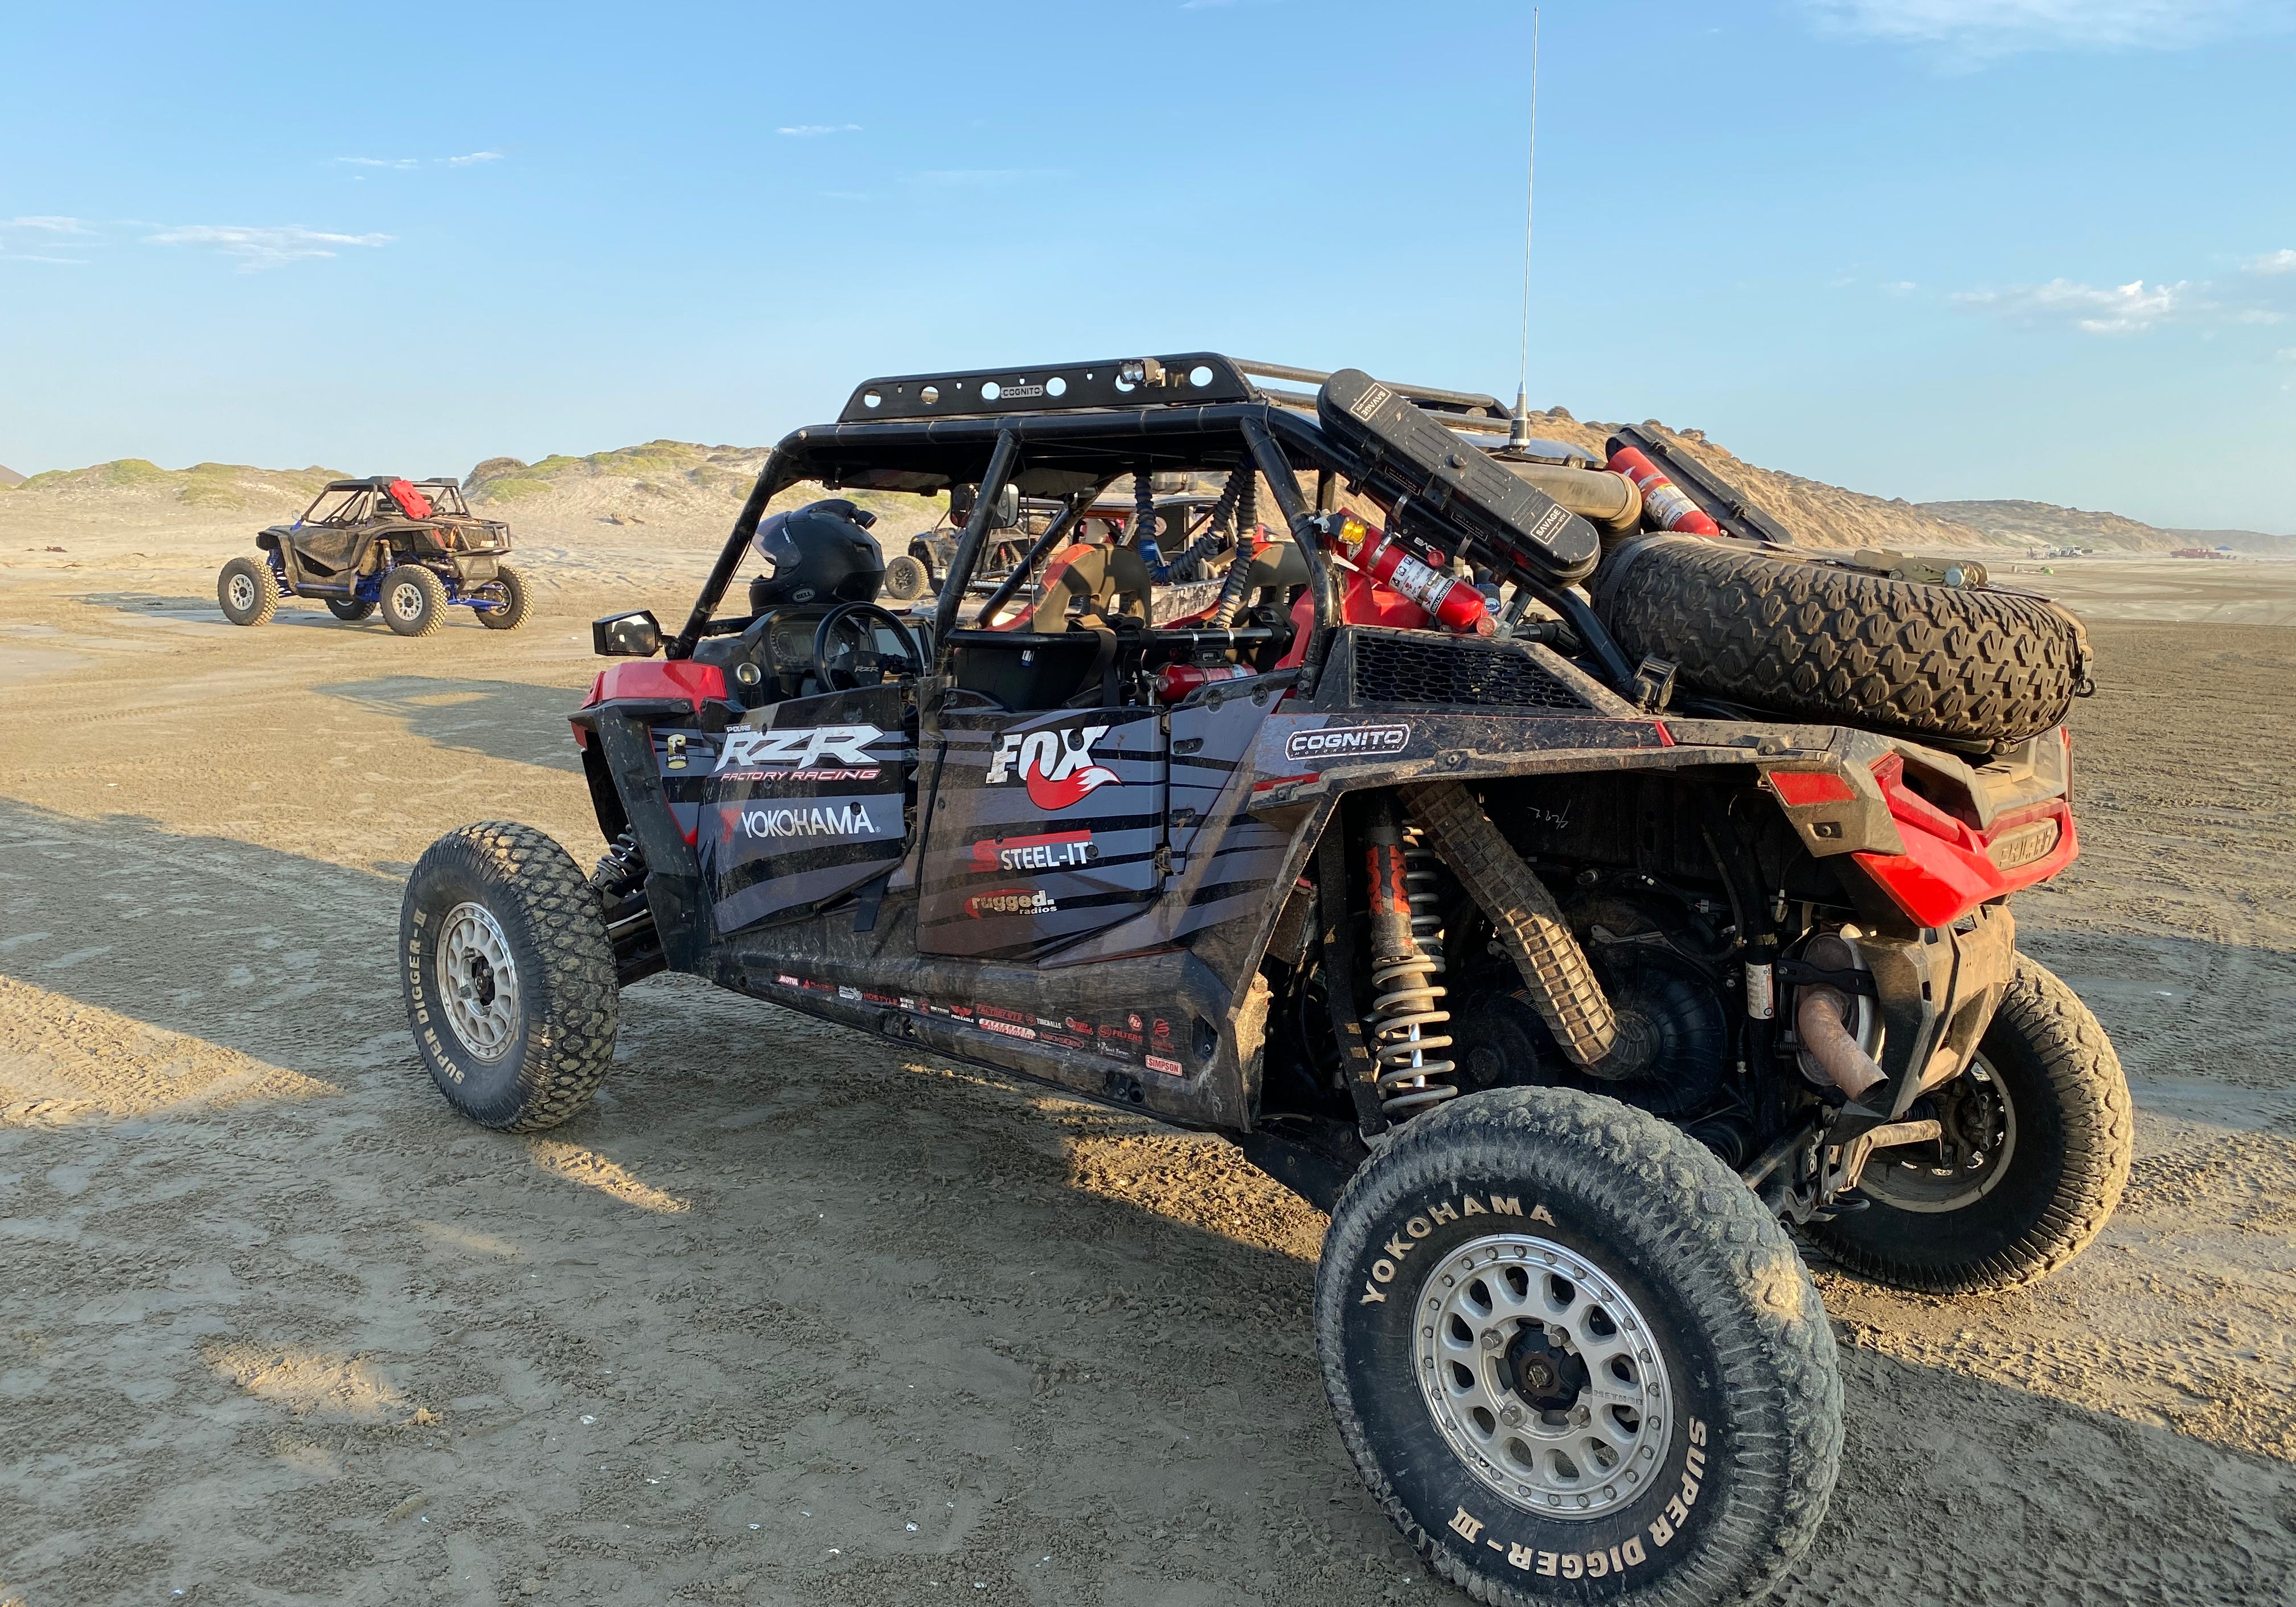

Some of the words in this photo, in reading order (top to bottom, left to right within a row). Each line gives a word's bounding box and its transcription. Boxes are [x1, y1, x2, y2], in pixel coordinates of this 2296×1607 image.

[1003, 387, 1040, 396] COGNITO
[1360, 391, 1386, 416] SAVAGE
[1536, 509, 1561, 536] SAVAGE
[1558, 513, 1567, 522] UTV
[796, 591, 812, 600] BELL
[726, 724, 751, 733] POLARIS
[1292, 730, 1403, 751] COGNITO
[714, 725, 884, 773] RZR
[986, 725, 1110, 784] FOX
[1294, 745, 1396, 756] MOTORSPORTS
[721, 770, 789, 781] FACTORY
[789, 769, 882, 781] RACING
[1001, 842, 1089, 871] STEEL-IT
[1019, 906, 1057, 915] radios
[778, 975, 798, 986] MOTUL
[863, 993, 898, 1005] HOSTYLE
[1112, 1030, 1143, 1042] FILTERS
[424, 1027, 465, 1085] SUPER
[1149, 1058, 1179, 1073] SIMPSON
[1359, 1195, 1557, 1305] YOKOHAMA
[1593, 1389, 1644, 1405] METHOD
[1648, 1416, 1706, 1547] SUPER
